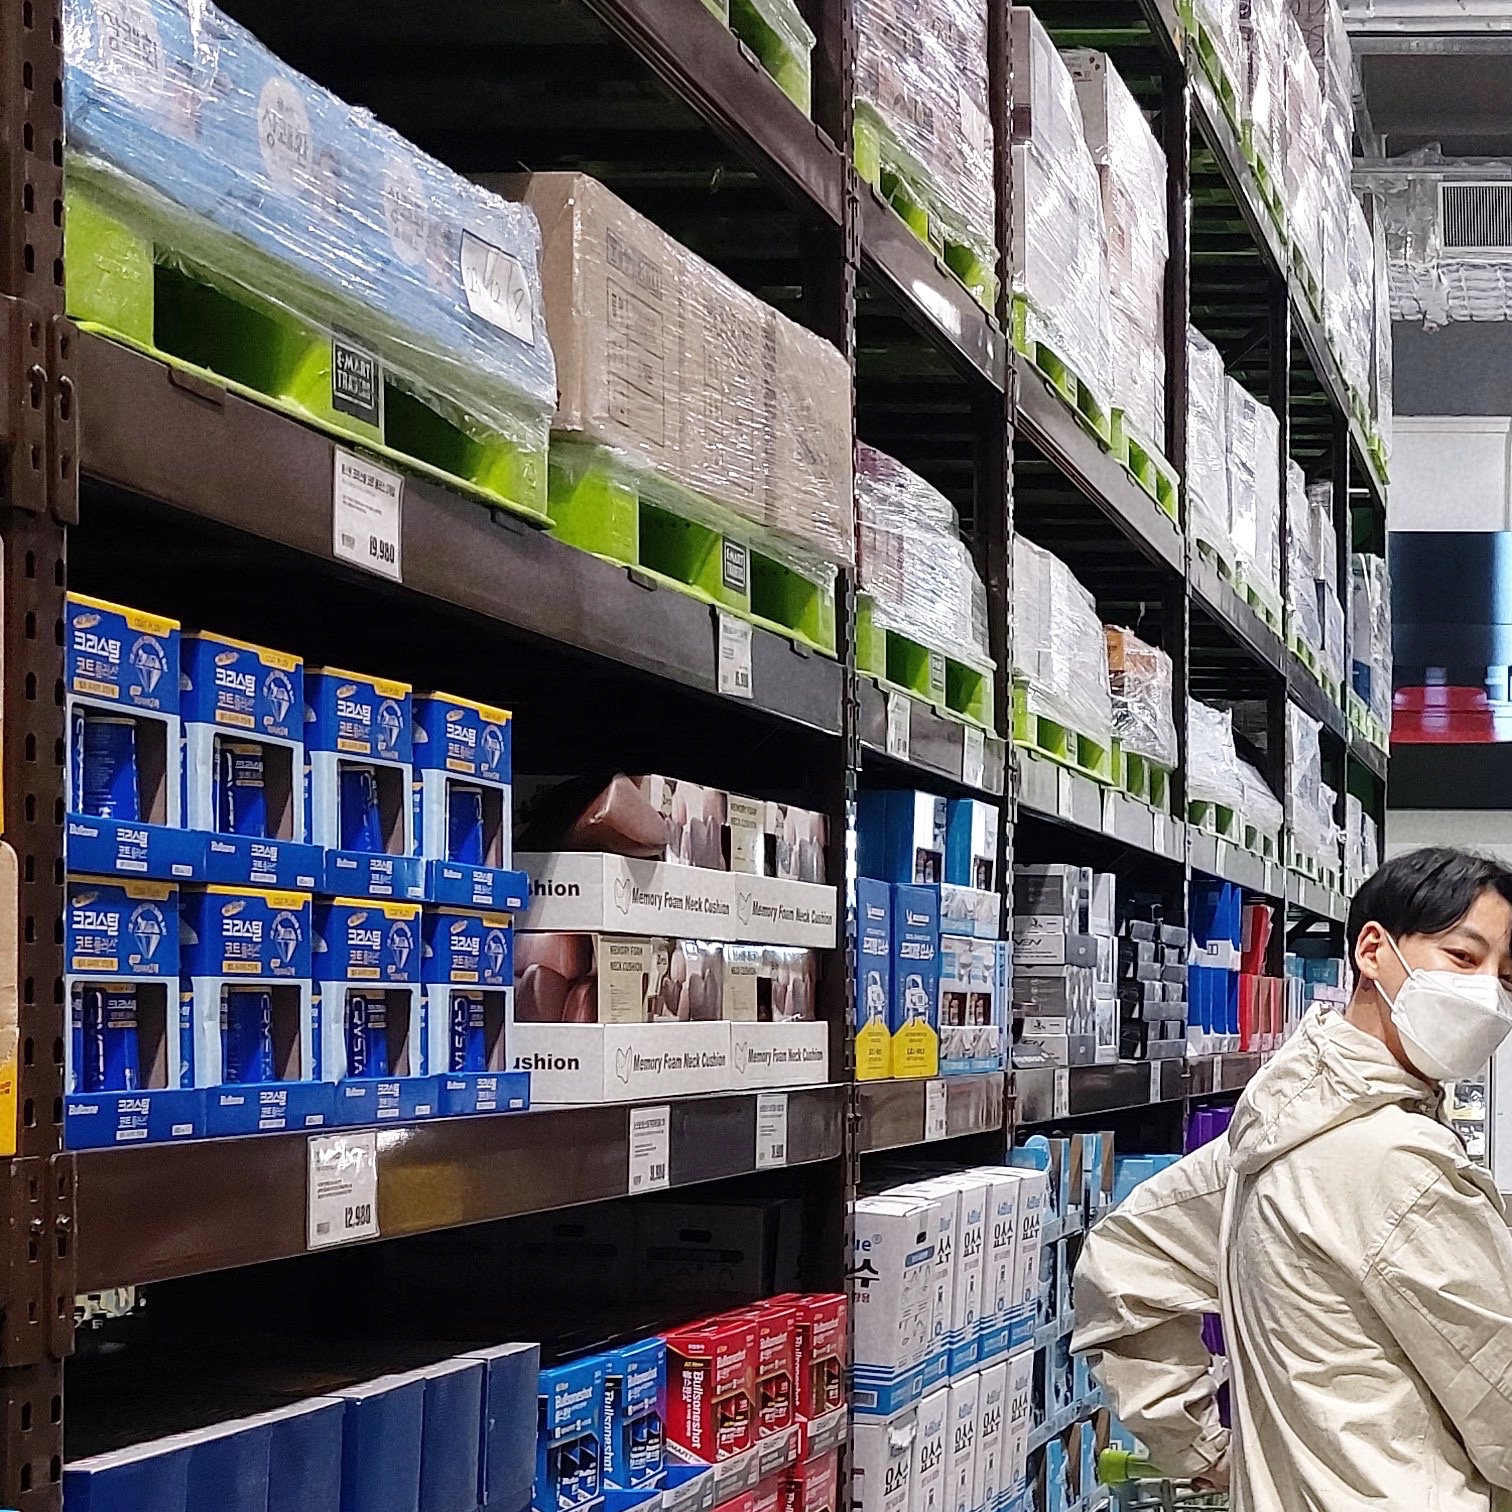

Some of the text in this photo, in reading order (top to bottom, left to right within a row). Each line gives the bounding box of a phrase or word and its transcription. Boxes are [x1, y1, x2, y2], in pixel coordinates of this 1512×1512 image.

[369, 532, 396, 565] 19,980
[73, 631, 121, 663] 크리스탈
[215, 668, 256, 697] 크리스탈
[337, 700, 372, 725] 크리스탈
[446, 723, 477, 747] 크리스탈
[632, 888, 730, 916] Memory Foam Neck Cushion
[752, 901, 777, 923] Memory
[779, 905, 794, 921] Foam
[796, 908, 811, 922] Neck
[72, 911, 119, 936] 크리스탈
[222, 919, 263, 942] 크리스탈
[347, 928, 382, 949] 크리스탈
[450, 935, 481, 955] 크리스탈
[633, 1051, 726, 1075] Memory Foam Neck Cushion
[748, 1049, 772, 1069] Memory
[345, 1204, 371, 1230] 12,980
[1022, 1213, 1040, 1241] 요소수
[963, 1226, 982, 1258] 요소수
[993, 1219, 1013, 1249] 요소수
[692, 1370, 704, 1449] Bullsoneshot
[1011, 1391, 1028, 1424] 요소수
[983, 1405, 1001, 1439] 요소수
[954, 1420, 974, 1455] 요소수
[920, 1437, 943, 1475] 요소수
